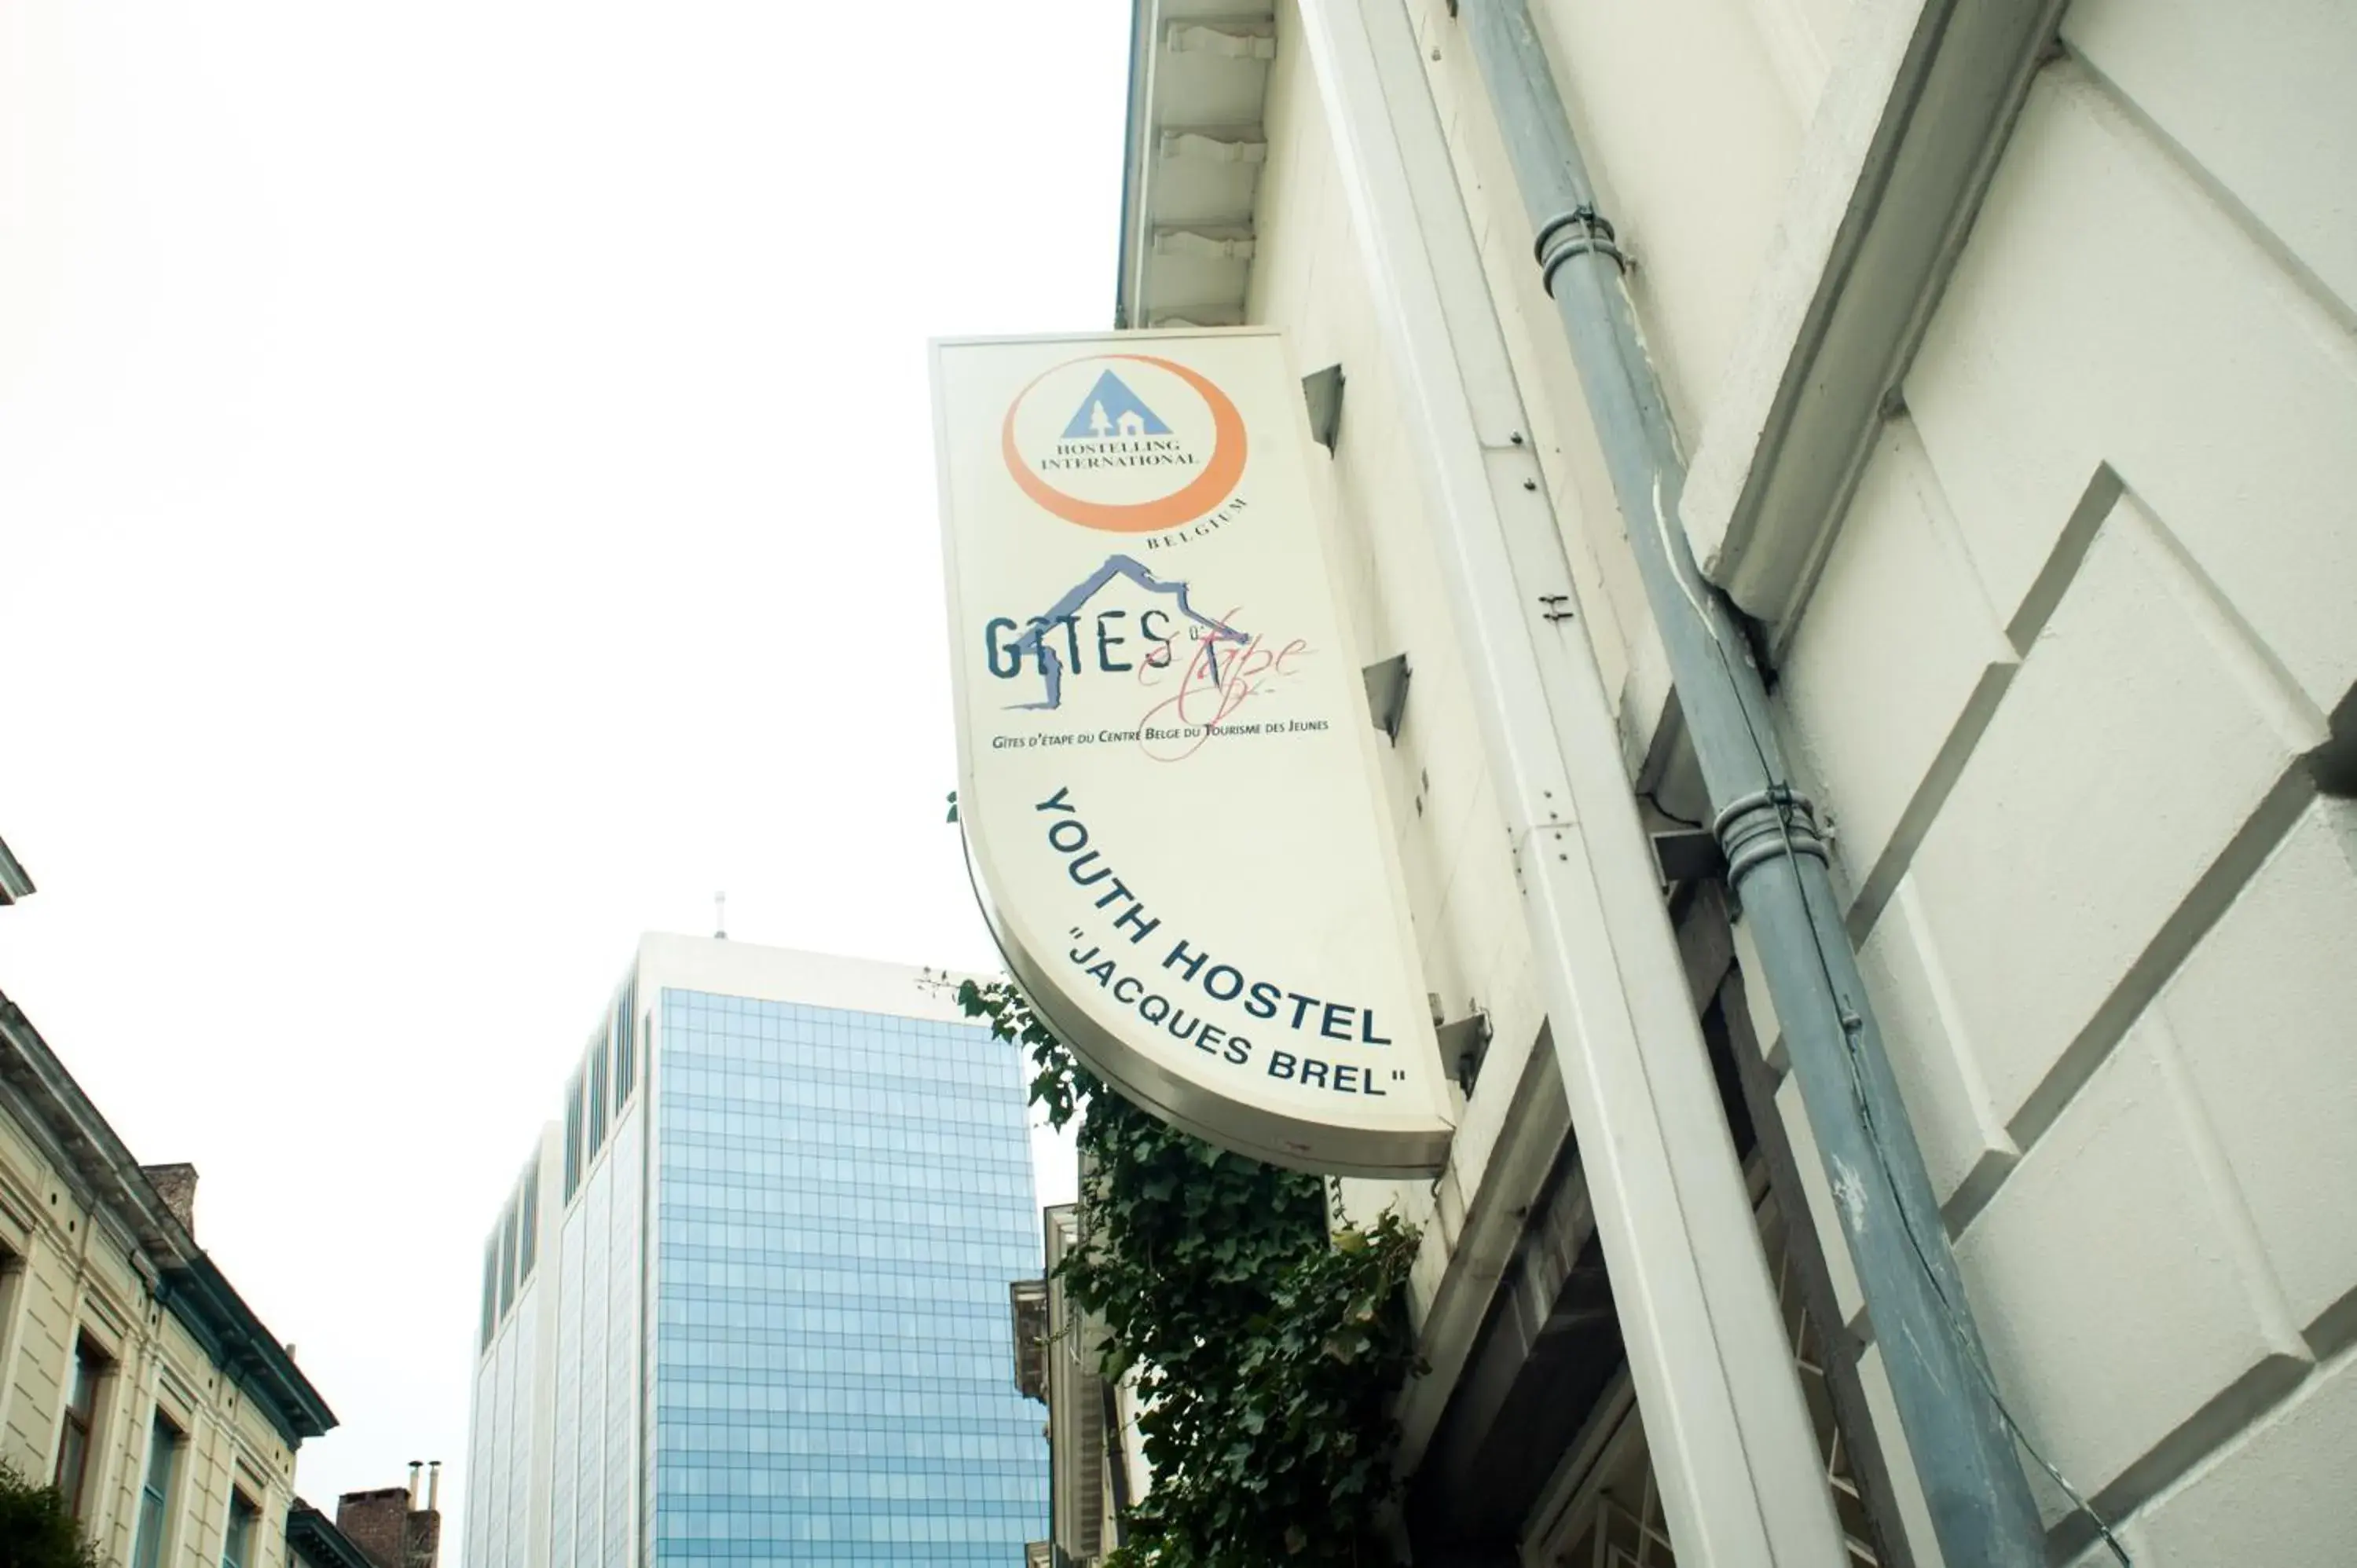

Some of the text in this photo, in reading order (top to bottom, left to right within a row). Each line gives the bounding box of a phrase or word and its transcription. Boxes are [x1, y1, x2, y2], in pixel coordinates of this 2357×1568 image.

[1041, 453, 1200, 471] INTERNATIONAL
[1057, 440, 1180, 456] HOSTELLING
[1146, 496, 1248, 550] BELGIUM
[1035, 786, 1392, 1046] YOUTH HOSTEL
[1069, 926, 1406, 1096] "JACQUES BREL"
